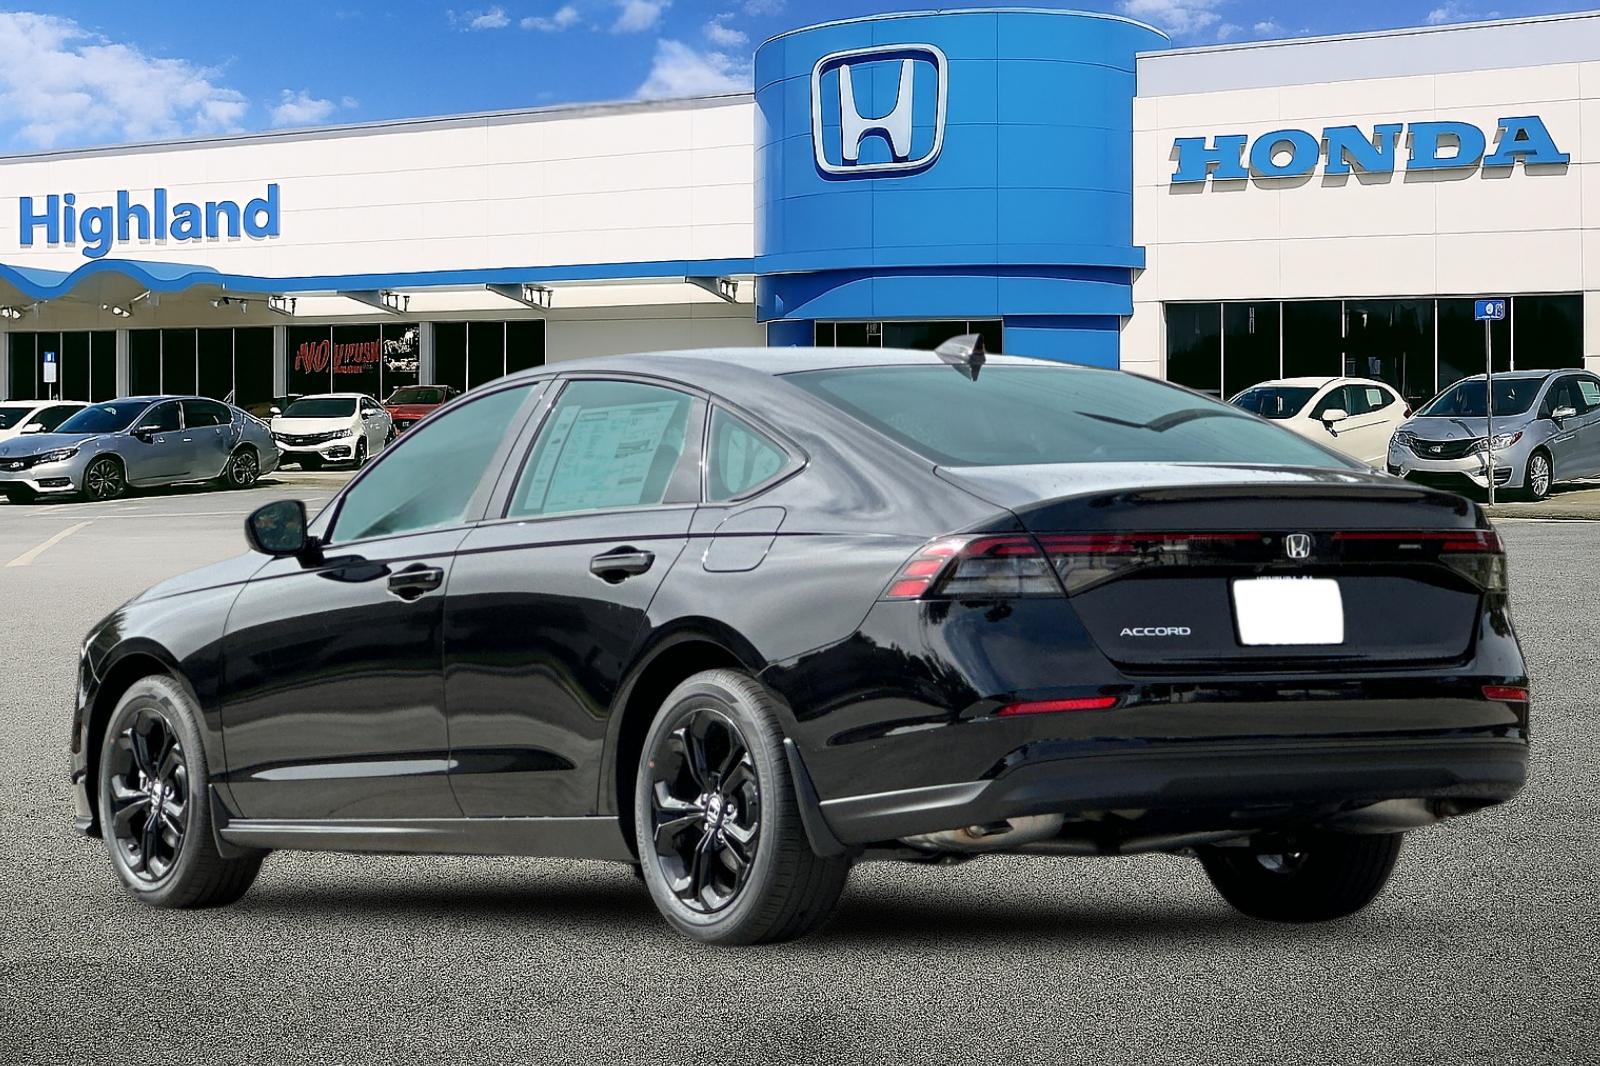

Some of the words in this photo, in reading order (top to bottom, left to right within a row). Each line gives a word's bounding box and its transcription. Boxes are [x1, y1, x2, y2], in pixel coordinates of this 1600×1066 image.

[1171, 115, 1570, 186] HONDA
[19, 183, 280, 259] Highland
[1120, 626, 1191, 637] ACCORD
